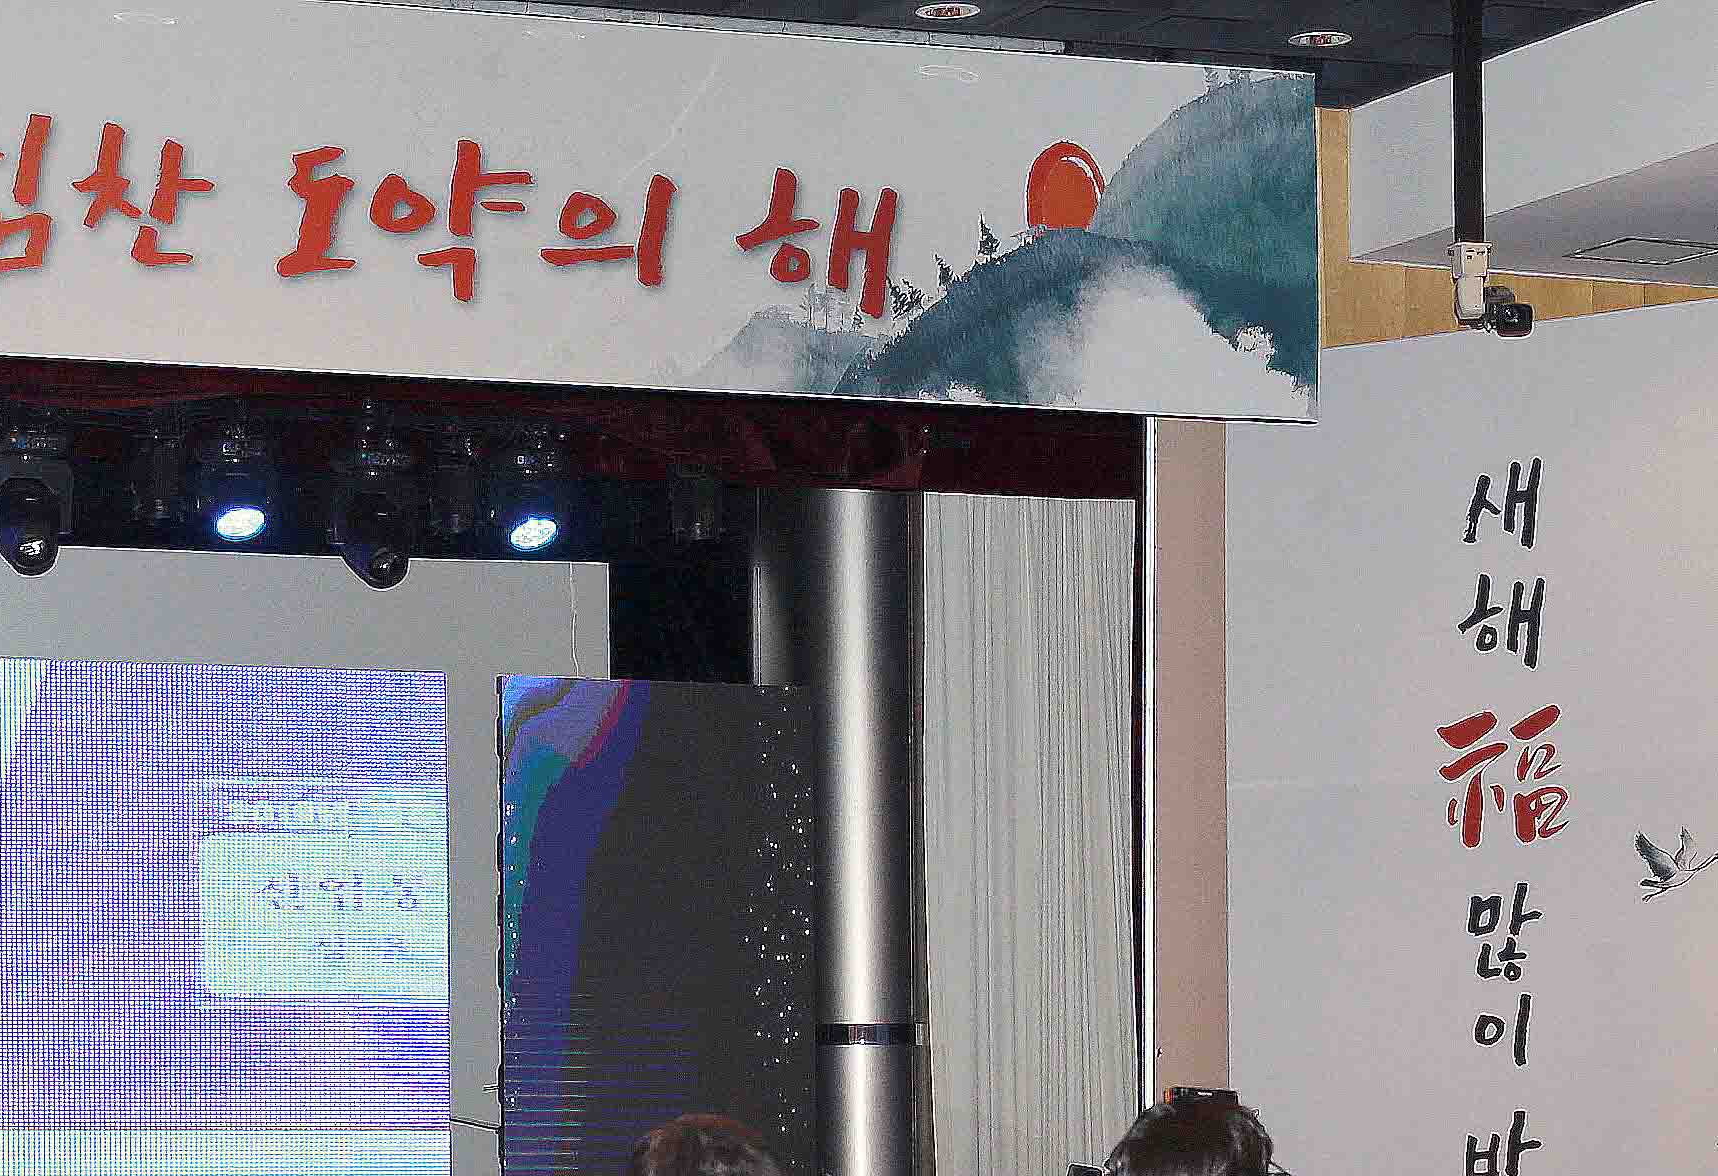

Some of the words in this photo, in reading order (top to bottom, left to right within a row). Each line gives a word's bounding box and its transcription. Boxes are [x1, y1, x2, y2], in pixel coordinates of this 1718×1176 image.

[278, 141, 675, 301] 도약의
[738, 169, 896, 318] 해
[1457, 457, 1546, 670] 새해
[1437, 705, 1568, 848] 福
[1467, 882, 1543, 1067] 많이
